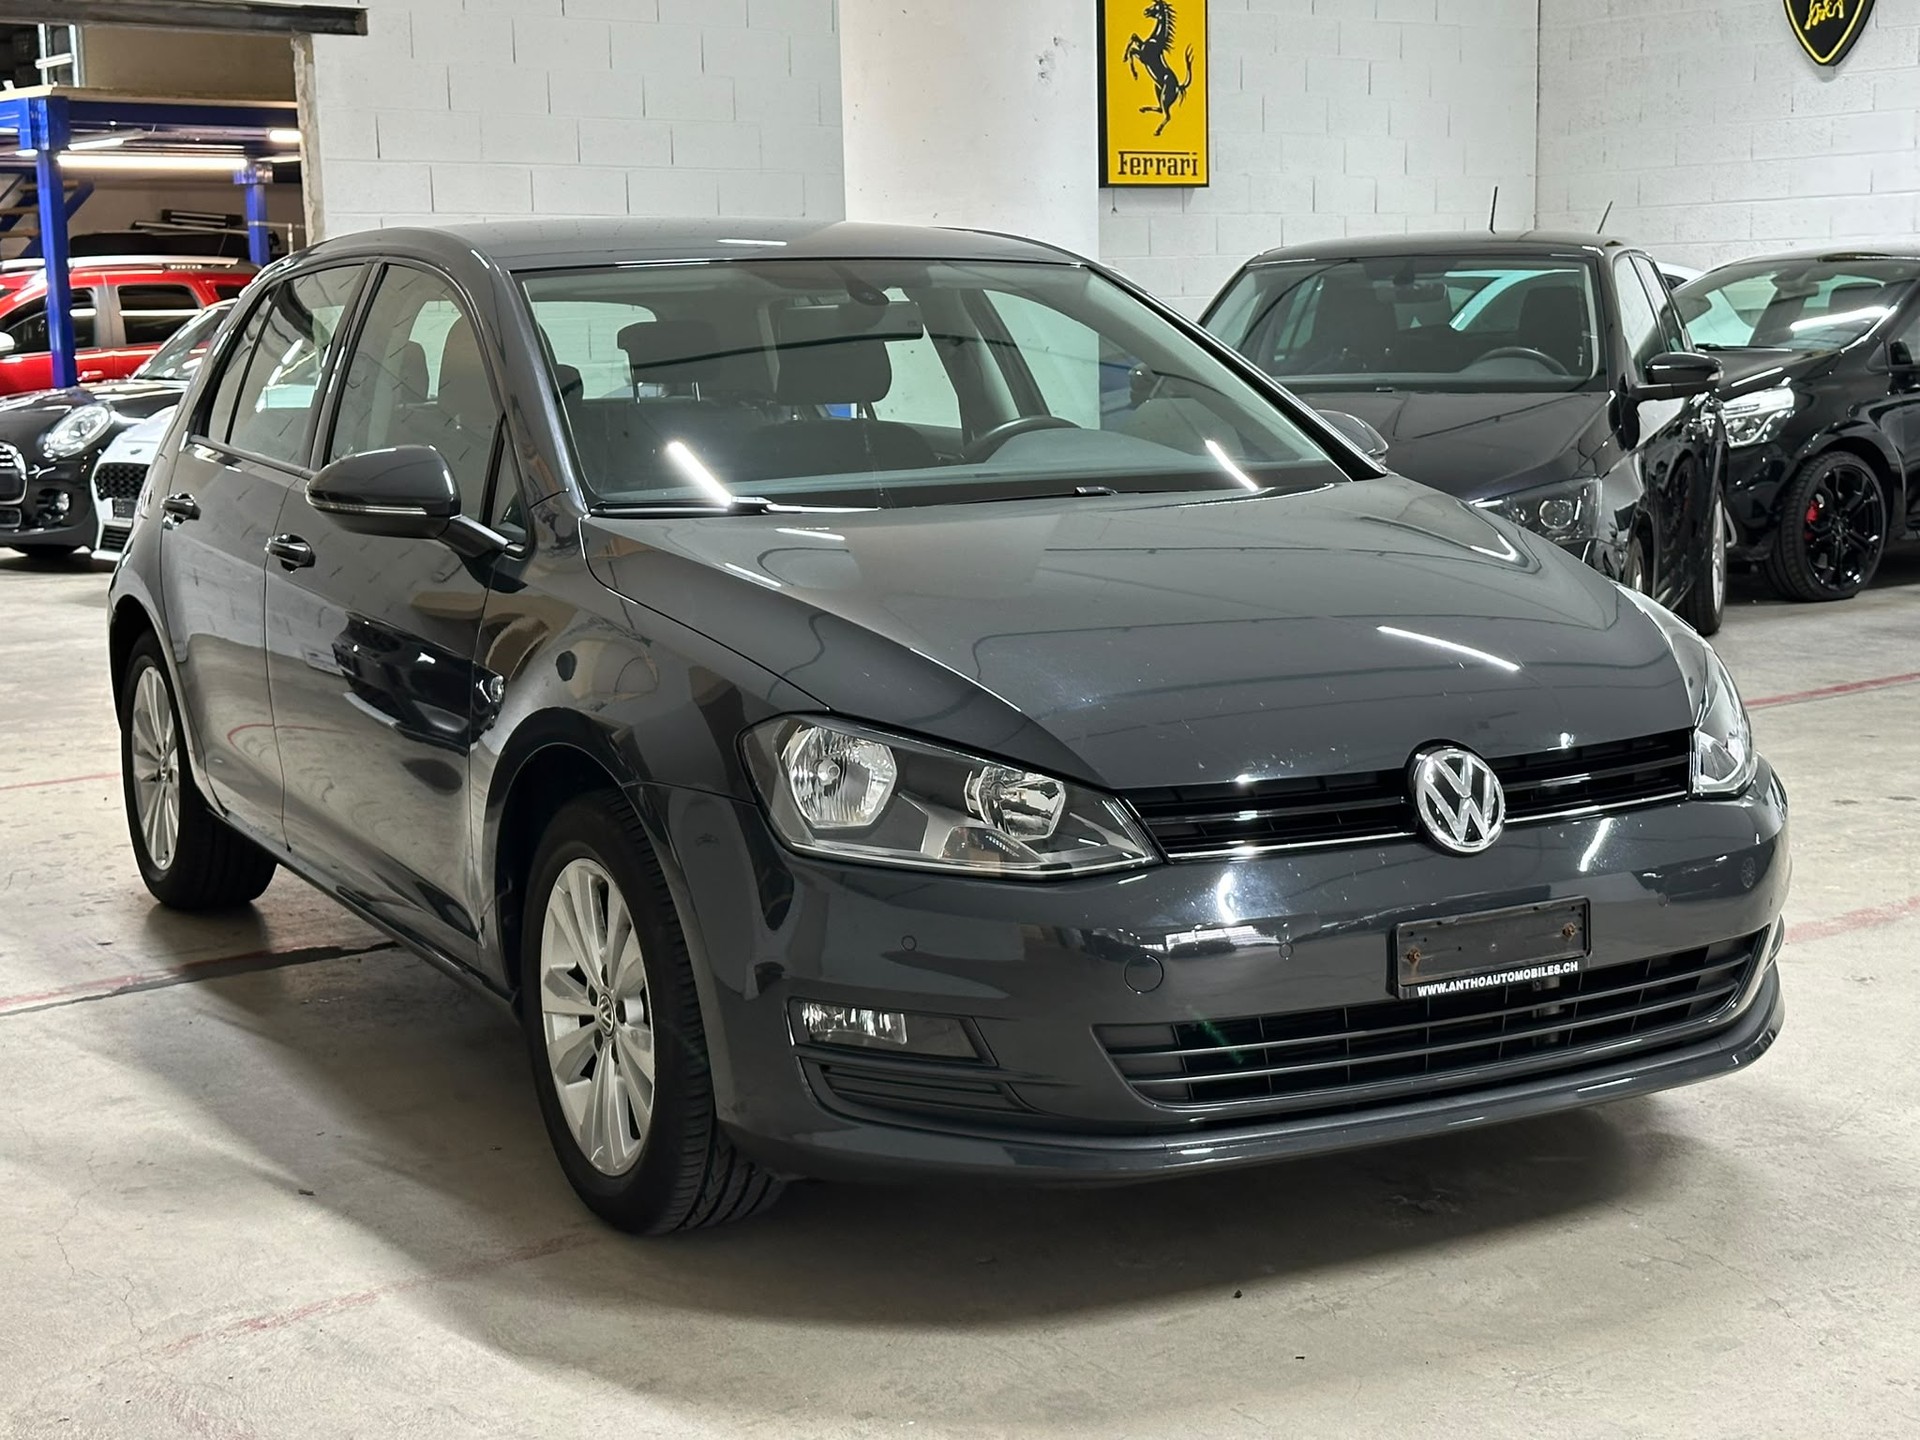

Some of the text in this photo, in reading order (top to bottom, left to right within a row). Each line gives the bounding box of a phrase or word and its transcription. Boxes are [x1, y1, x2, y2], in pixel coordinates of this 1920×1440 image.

[1118, 151, 1198, 176] Ferrari
[1419, 750, 1502, 849] VW
[1417, 961, 1579, 997] WWW.ANTHOAUTOMOBILES.CH
